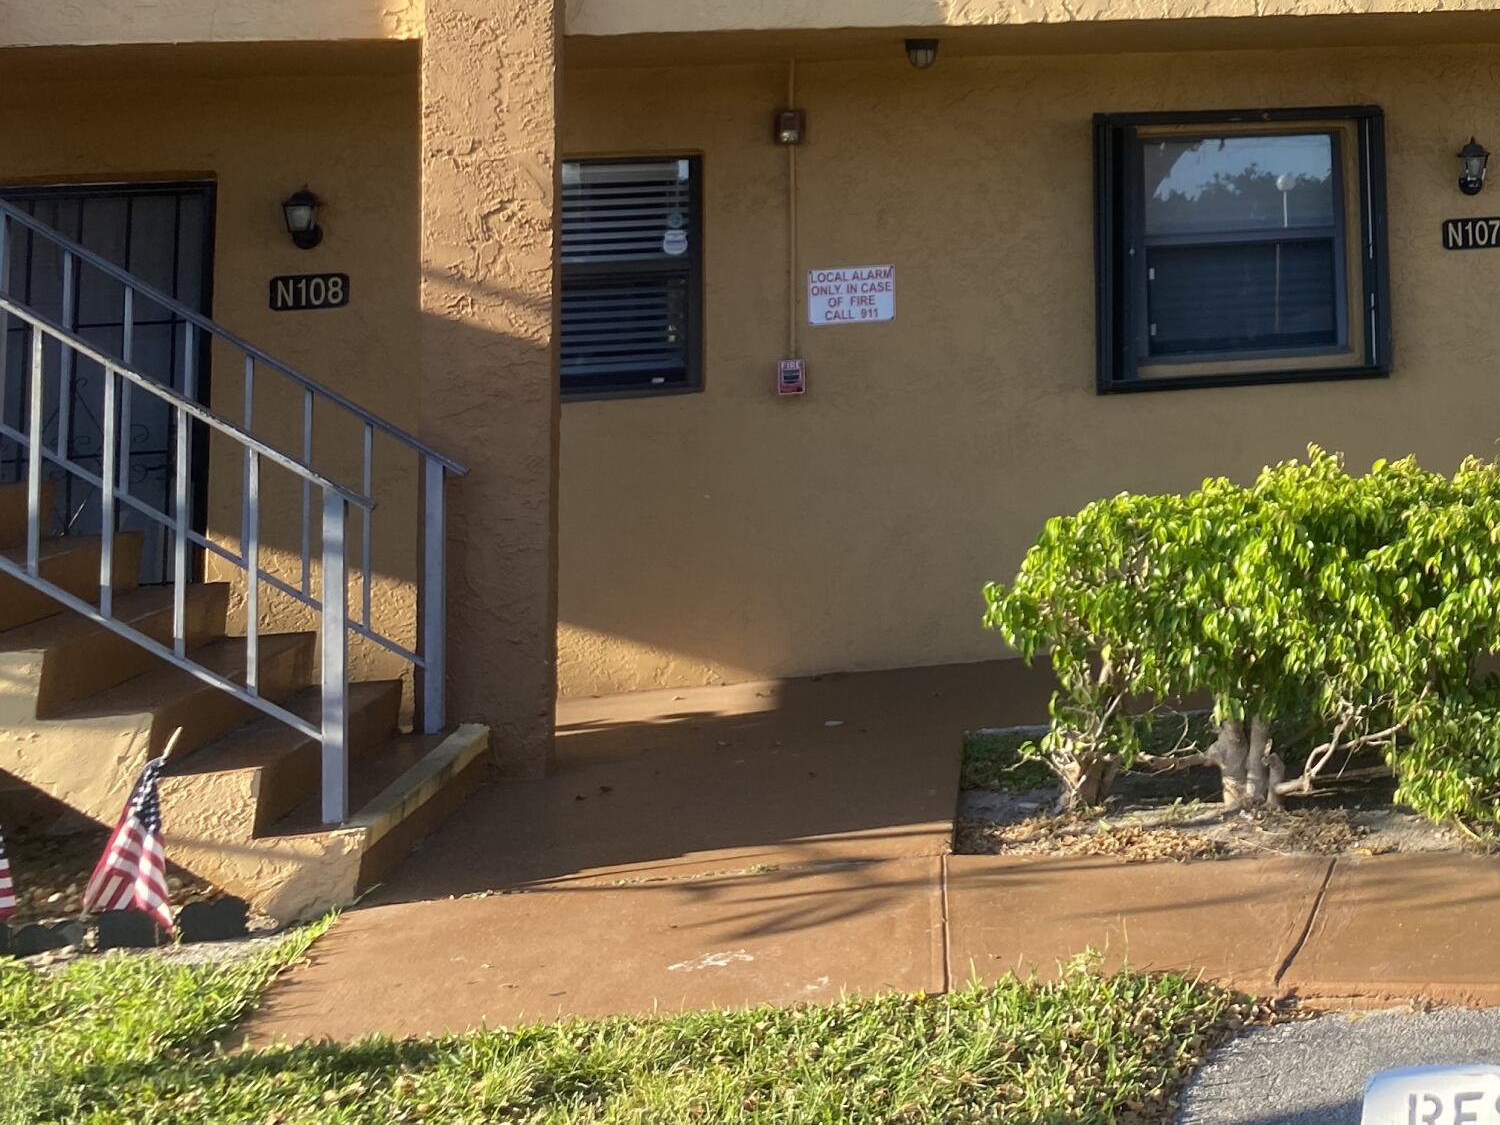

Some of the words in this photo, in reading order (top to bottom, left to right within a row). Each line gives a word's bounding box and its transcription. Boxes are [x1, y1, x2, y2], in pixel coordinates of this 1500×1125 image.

[1447, 219, 1500, 248] N107
[810, 271, 848, 284] LOCAL
[851, 269, 893, 281] ALARM
[277, 277, 344, 307] N108
[846, 283, 857, 293] IN
[860, 281, 892, 293] CASE
[828, 297, 844, 308] OF
[850, 295, 876, 306] FIRE
[825, 309, 854, 321] CALL
[860, 308, 879, 319] 911
